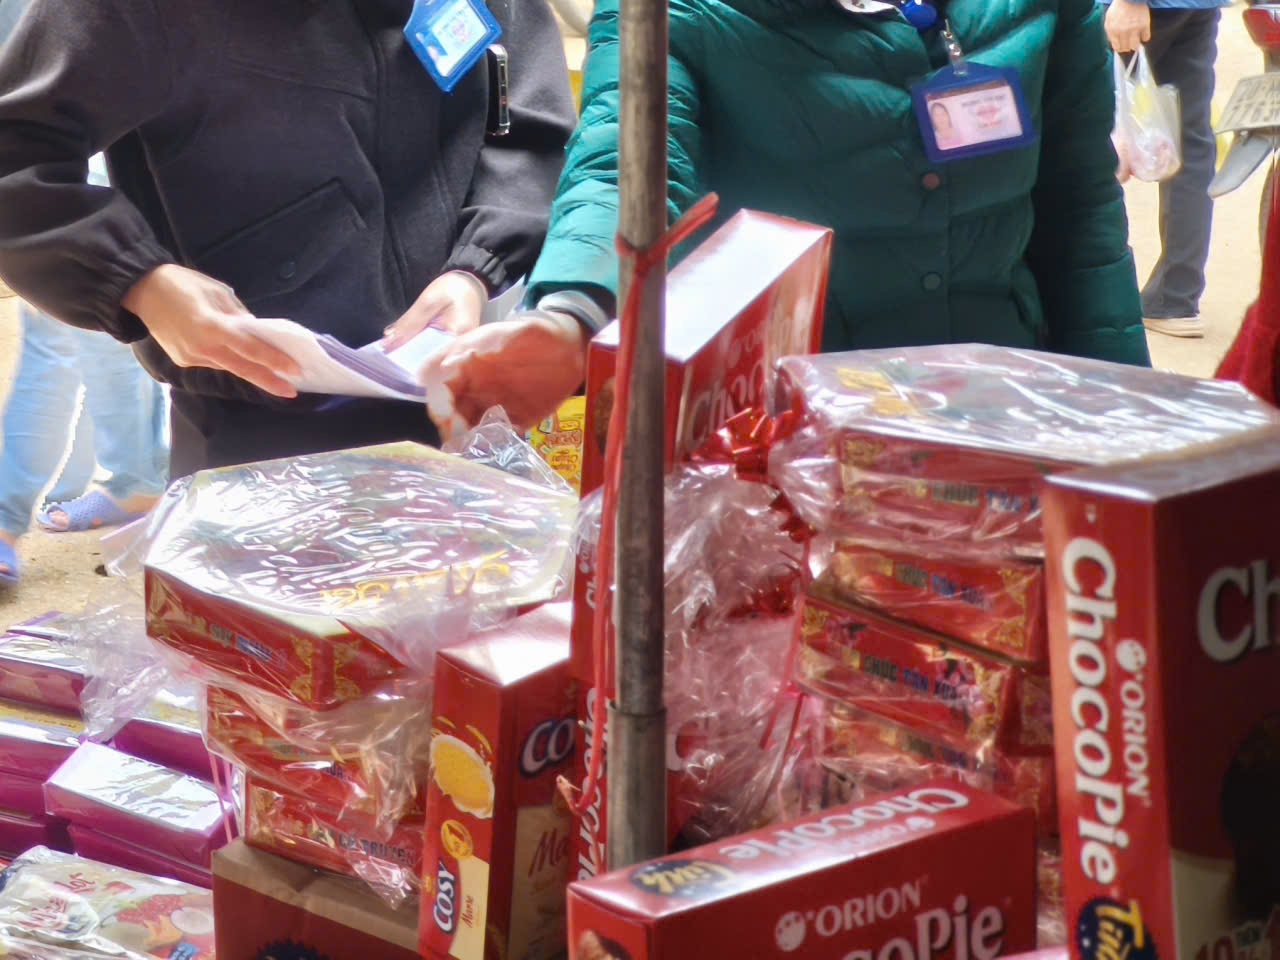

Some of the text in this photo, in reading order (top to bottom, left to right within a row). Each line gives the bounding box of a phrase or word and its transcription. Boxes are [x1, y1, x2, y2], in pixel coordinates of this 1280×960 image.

[1120, 680, 1150, 797] ORION
[434, 860, 456, 933] COSY
[816, 881, 921, 937] ORION
